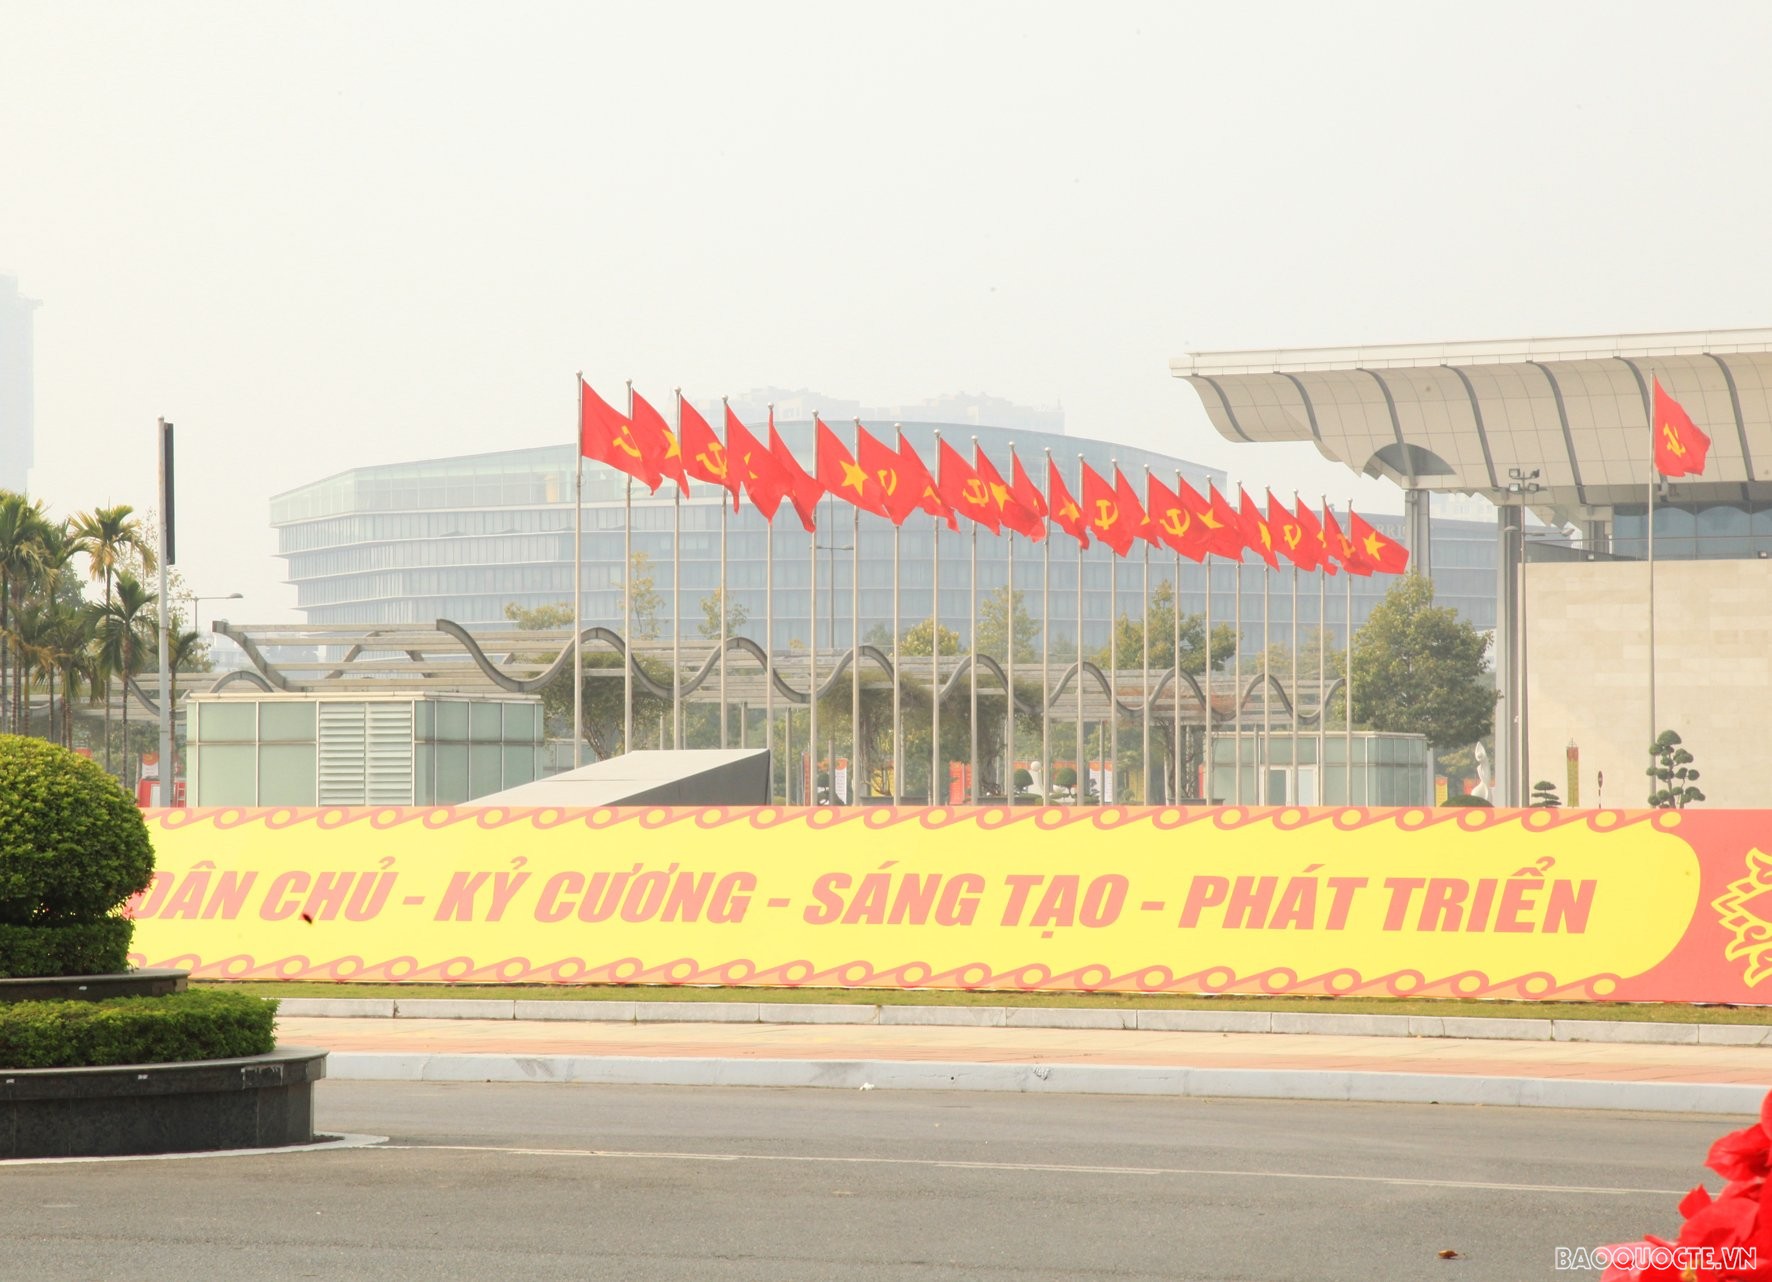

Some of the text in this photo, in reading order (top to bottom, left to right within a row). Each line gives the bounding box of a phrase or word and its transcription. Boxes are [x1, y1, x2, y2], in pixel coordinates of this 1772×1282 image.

[122, 859, 259, 920] DÂN
[258, 855, 398, 924] CHỦ
[434, 855, 532, 922] KỶ
[534, 862, 757, 924] CƯƠNG
[803, 860, 986, 927] SÁNG
[1000, 873, 1130, 939] TẠO
[1177, 863, 1370, 931] PHÁT
[1382, 855, 1598, 935] TRIỂN
